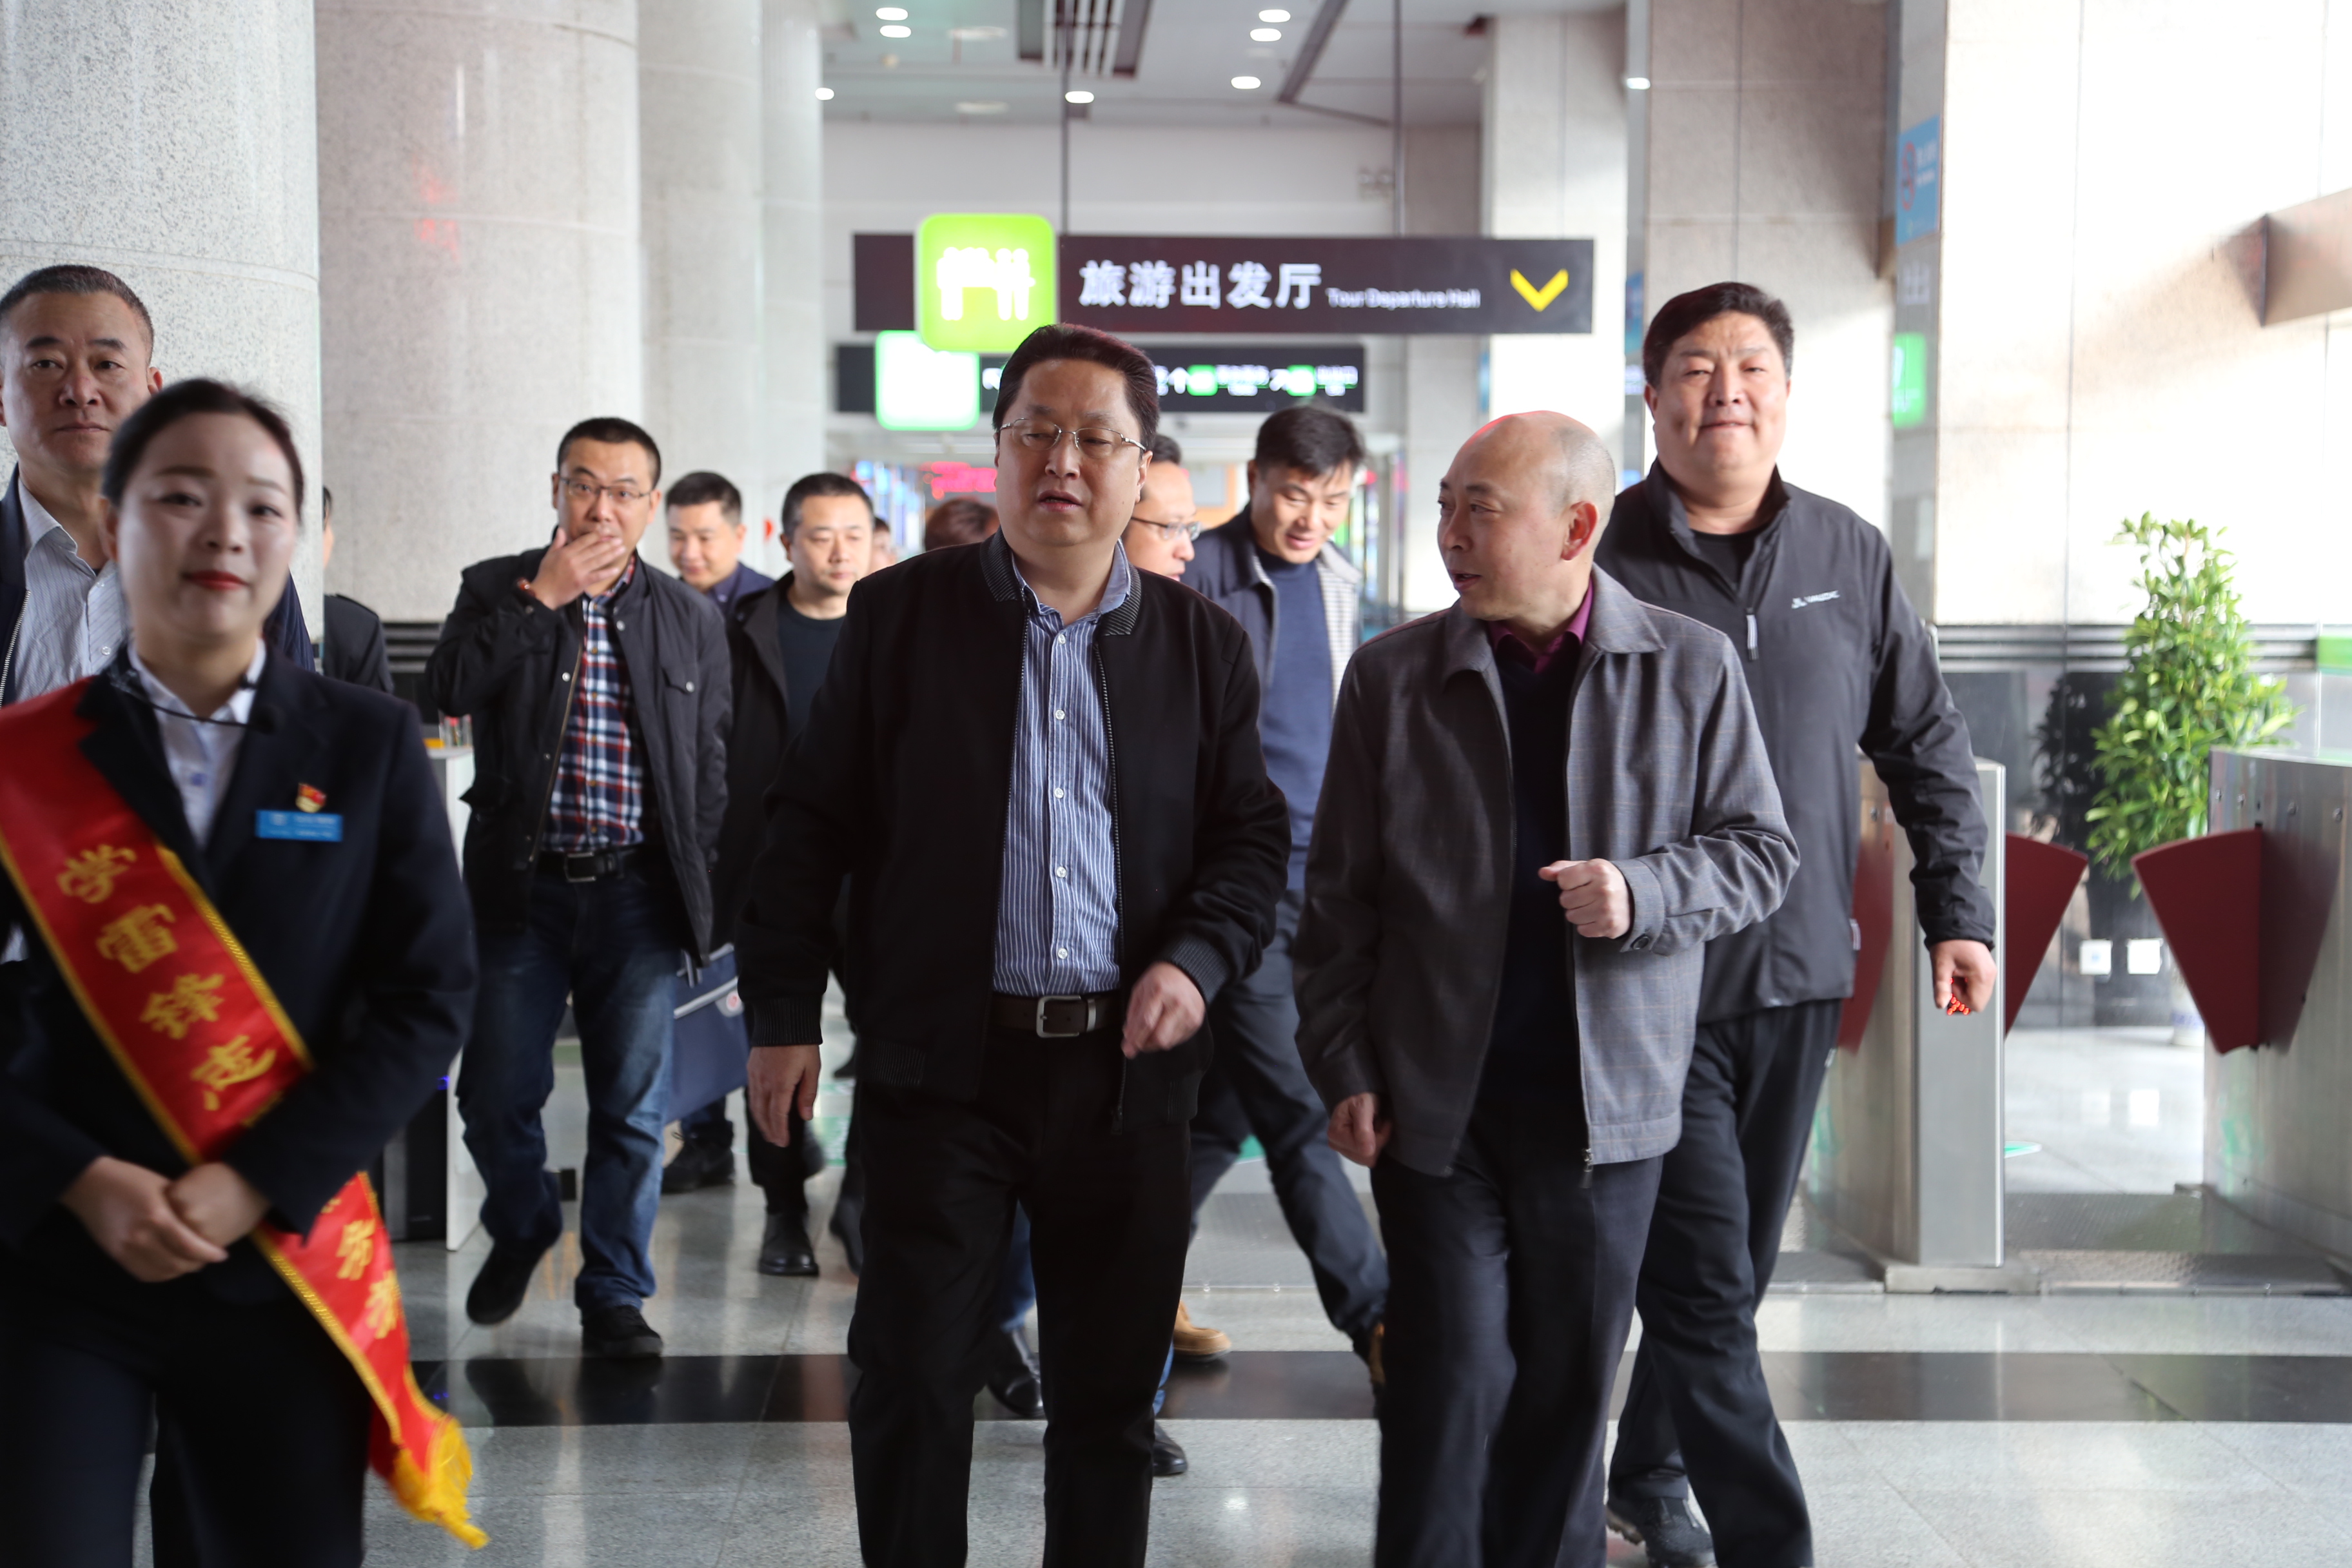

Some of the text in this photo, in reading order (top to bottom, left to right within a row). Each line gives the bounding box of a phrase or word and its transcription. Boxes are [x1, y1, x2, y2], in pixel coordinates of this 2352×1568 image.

[1079, 260, 1322, 309] 旅游出发厅
[1325, 288, 1481, 311] Tour Departure Hall
